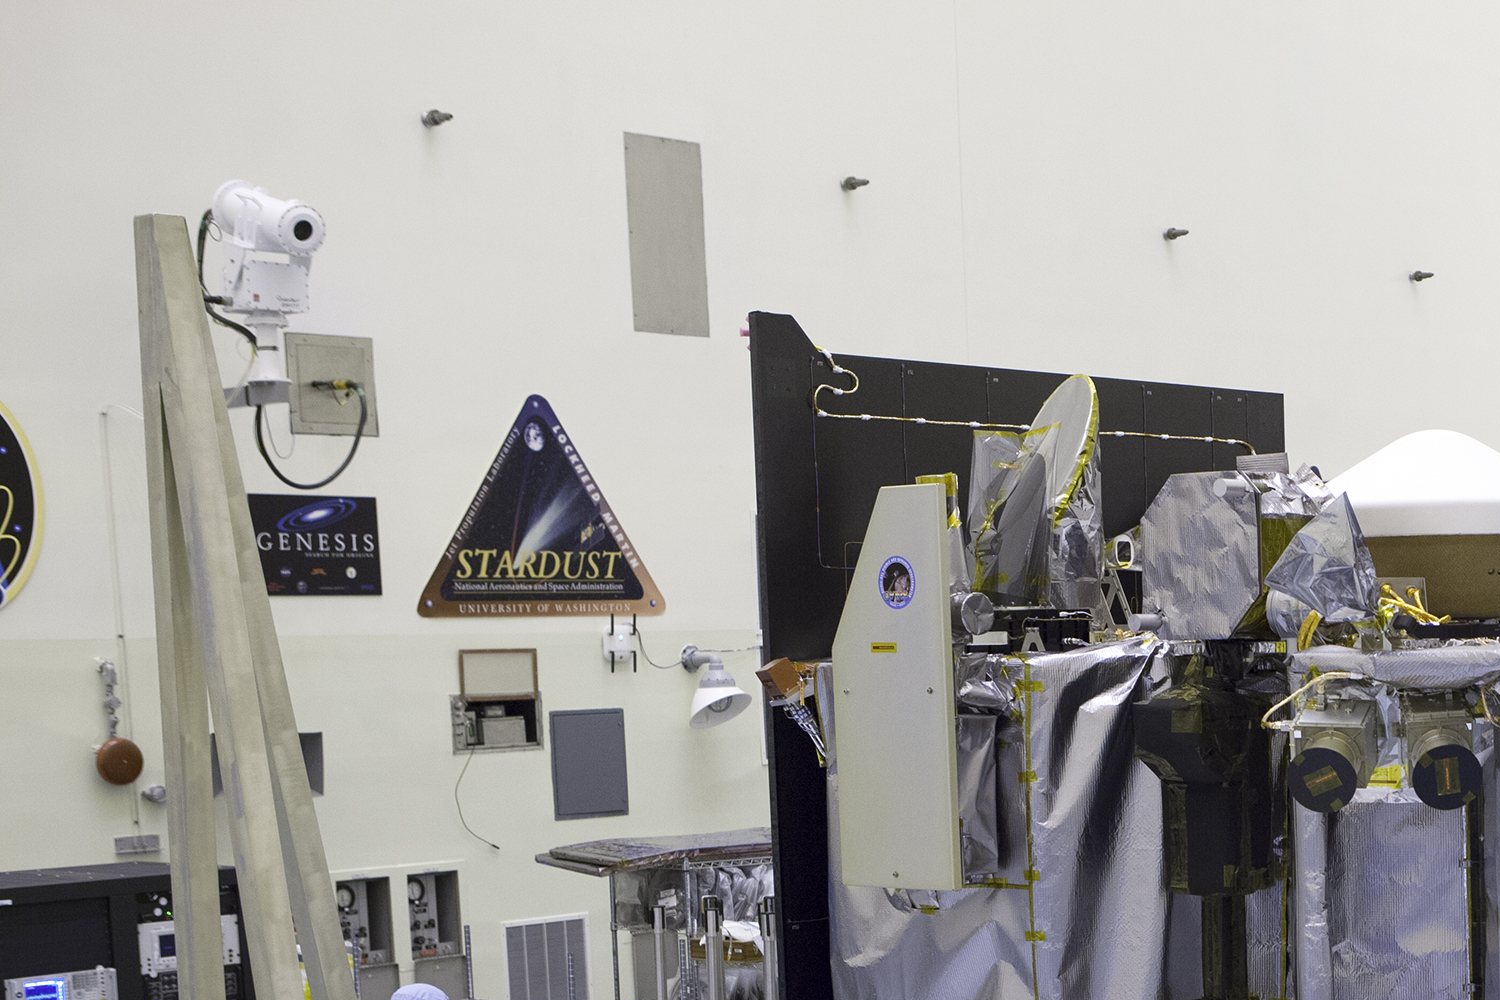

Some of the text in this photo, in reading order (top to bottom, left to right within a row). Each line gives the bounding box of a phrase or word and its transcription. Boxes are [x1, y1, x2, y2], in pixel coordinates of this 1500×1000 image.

[444, 426, 521, 560] Jet Propulsion Laboratory
[552, 424, 640, 569] LOCKHEED MARTIN
[257, 532, 375, 552] GENESIS
[456, 548, 623, 580] STARDUST
[454, 582, 624, 593] National Aeronautics and Space Administration
[459, 602, 632, 614] UNIVERSITY OF WASHINGTON
